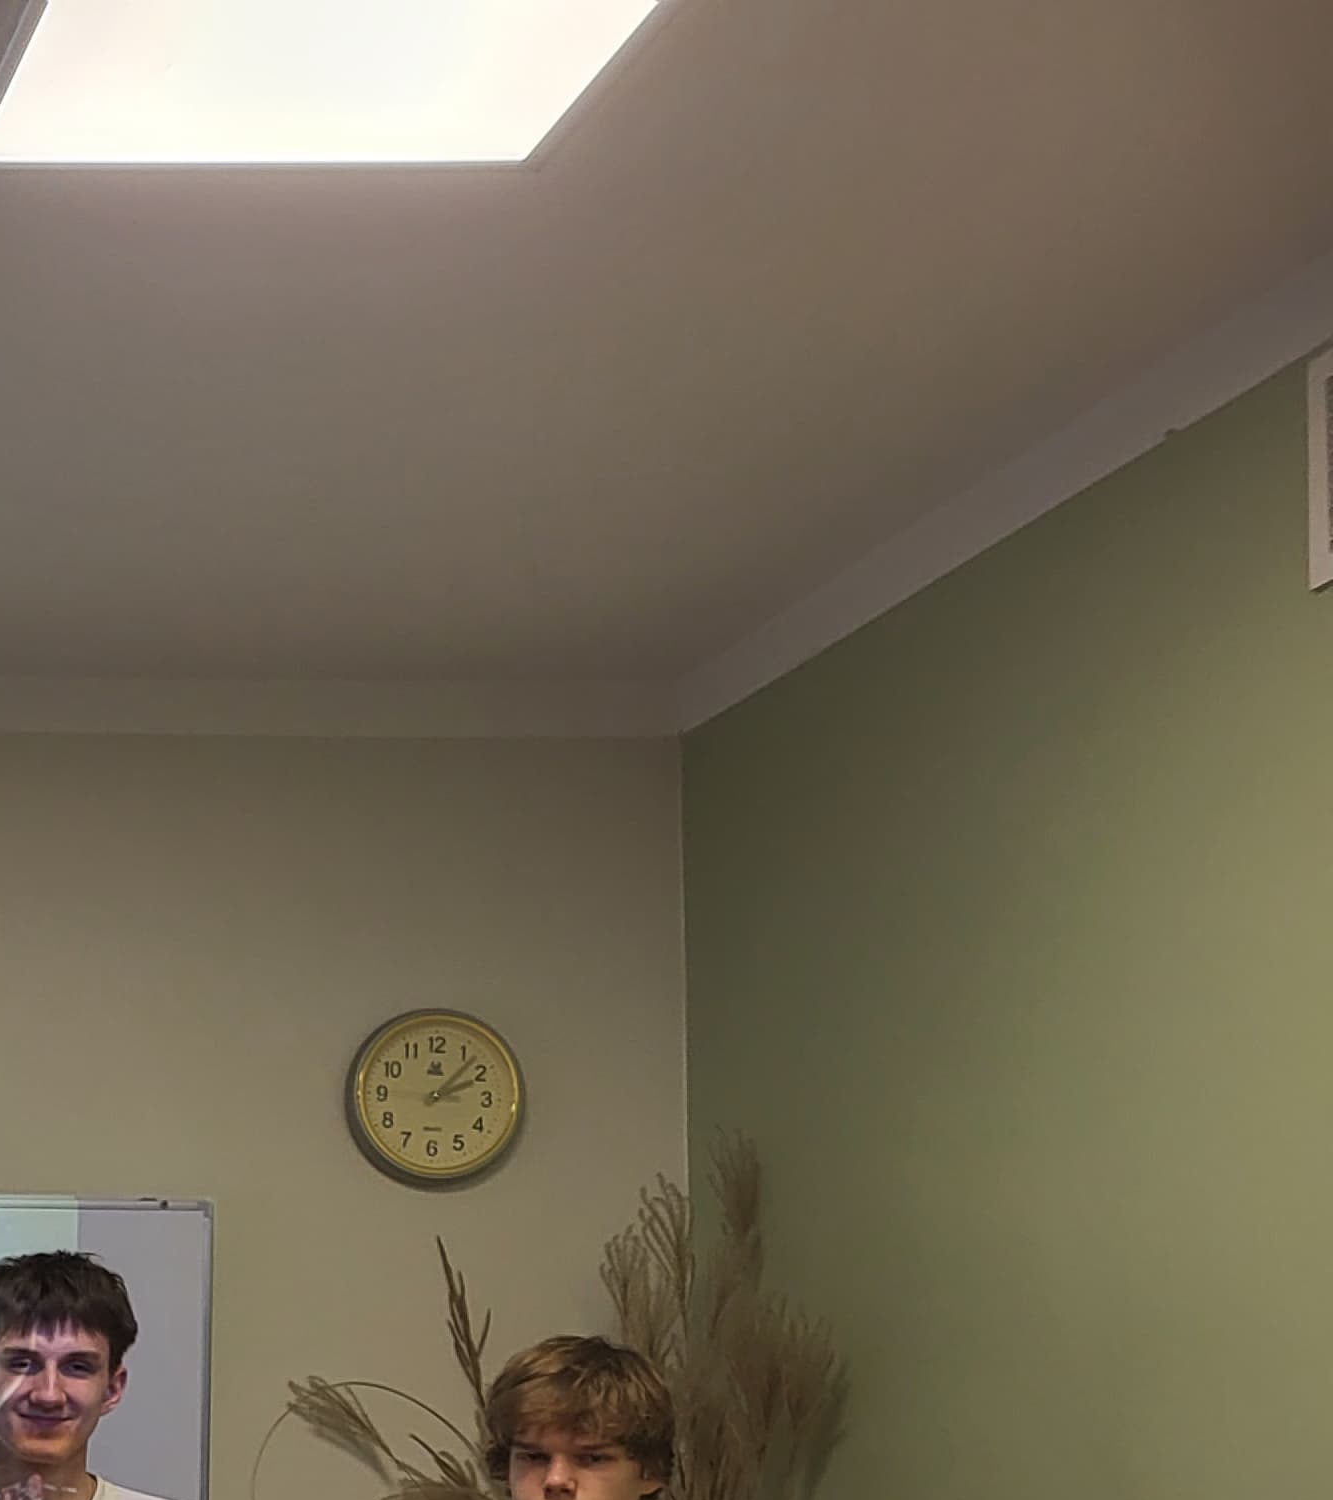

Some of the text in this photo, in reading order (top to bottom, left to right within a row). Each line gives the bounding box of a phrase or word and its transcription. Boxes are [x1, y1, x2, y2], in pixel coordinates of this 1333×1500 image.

[404, 1042, 418, 1060] 11
[429, 1036, 446, 1054] 12
[460, 1045, 467, 1061] 1
[384, 1061, 402, 1078] 10
[474, 1065, 487, 1082] 2
[376, 1085, 388, 1102] 9
[480, 1091, 493, 1108] 3
[382, 1111, 394, 1129] 8
[472, 1116, 484, 1133] 4
[400, 1131, 412, 1148] 7
[452, 1134, 465, 1151] 5
[426, 1140, 438, 1157] 6
